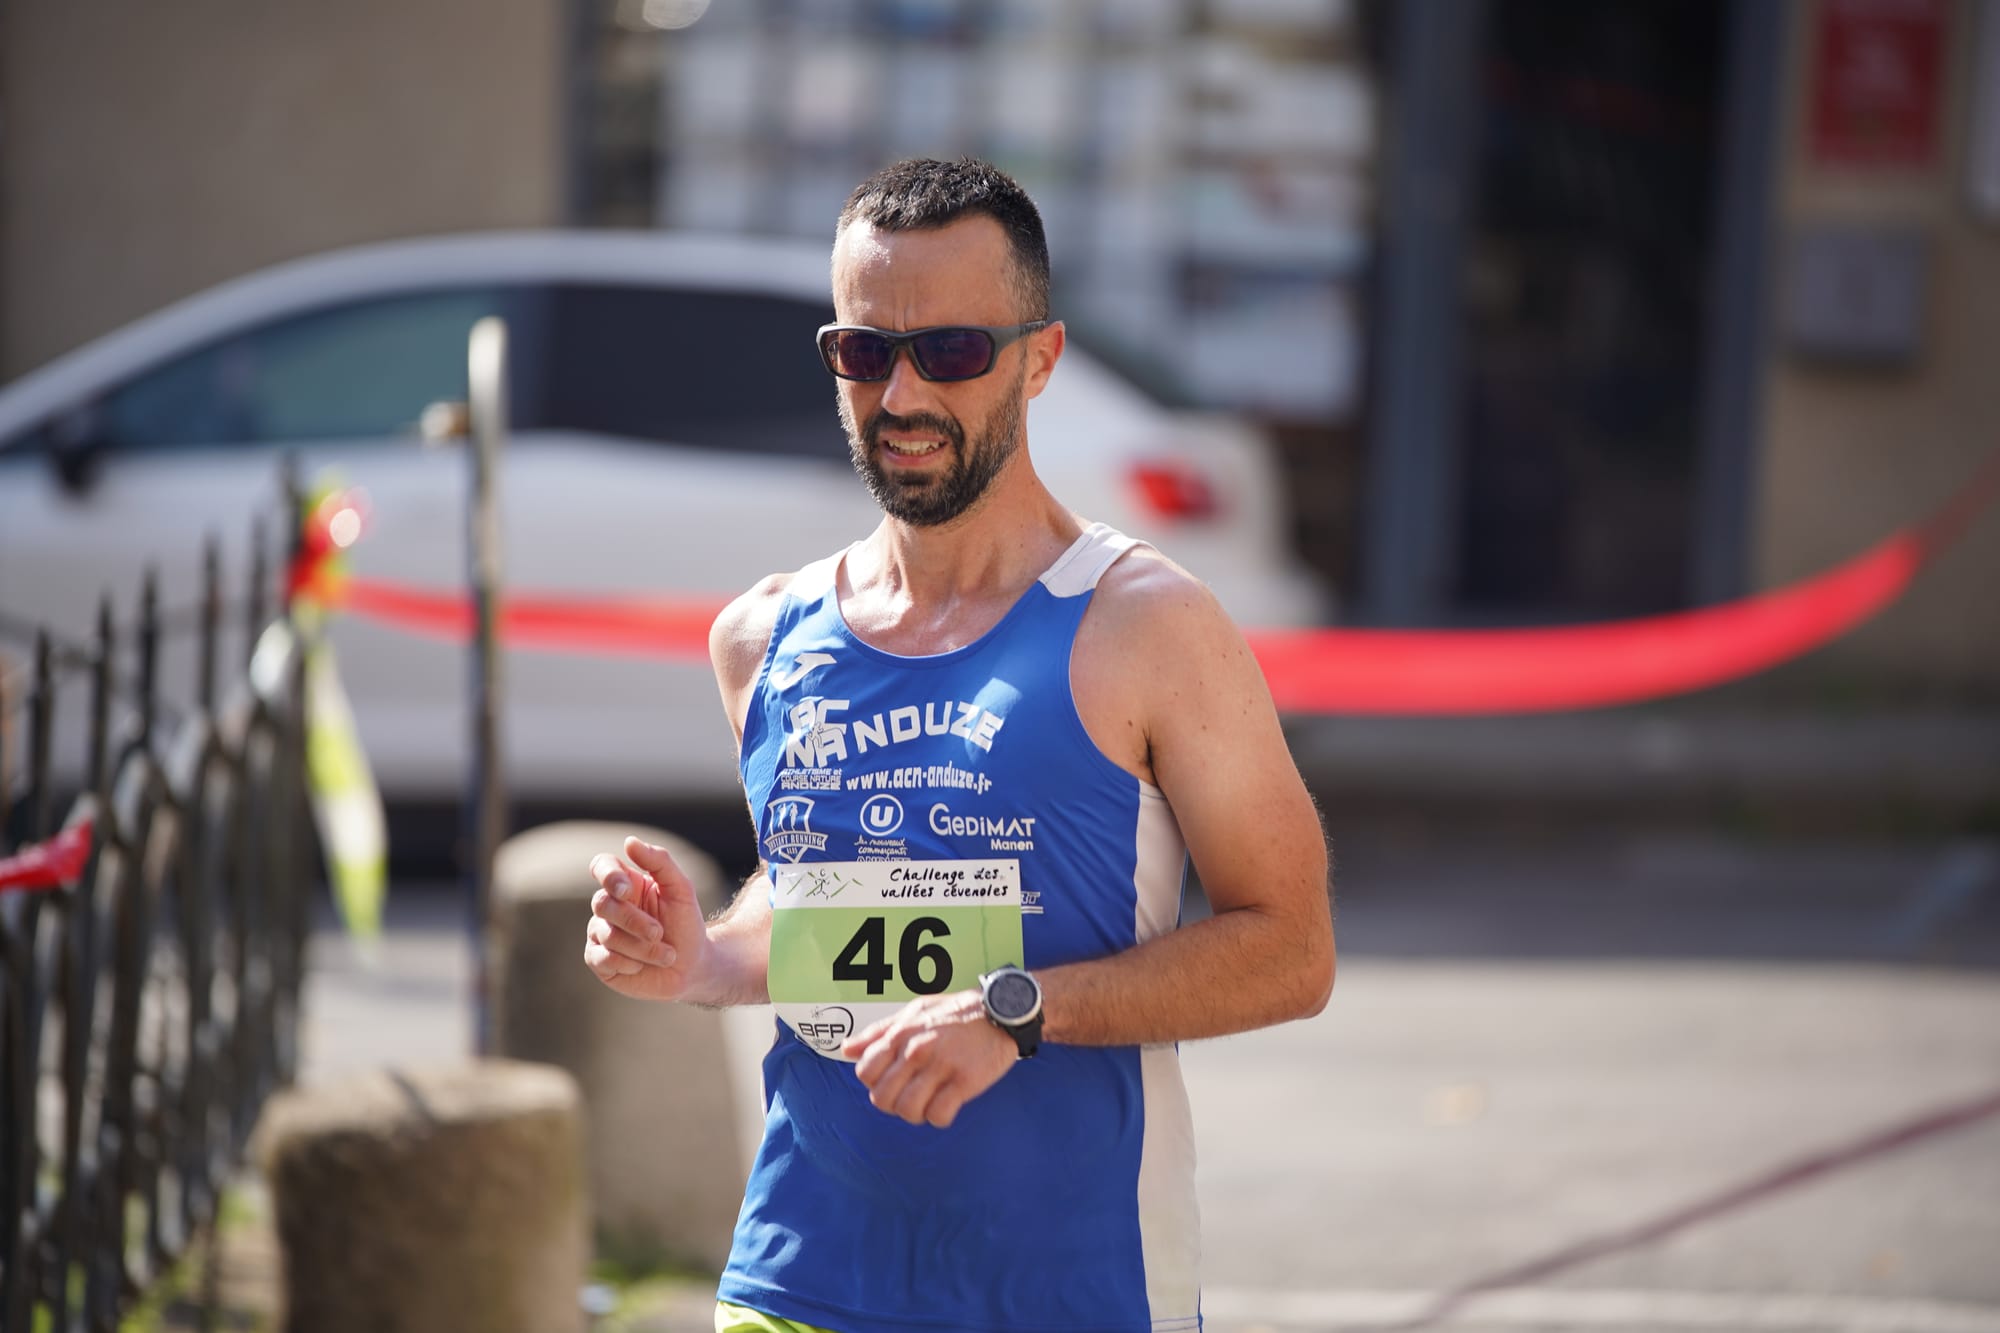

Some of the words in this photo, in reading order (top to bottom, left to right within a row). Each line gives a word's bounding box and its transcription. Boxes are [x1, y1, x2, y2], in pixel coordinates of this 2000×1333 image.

[781, 781, 841, 790] ANDUZE
[846, 760, 992, 795] www.acn-anduze.fr
[890, 868, 965, 885] Challenge
[881, 884, 934, 898] vallées
[943, 884, 1008, 898] cévenoles
[833, 916, 954, 996] 46
[797, 1022, 845, 1038] BFP
